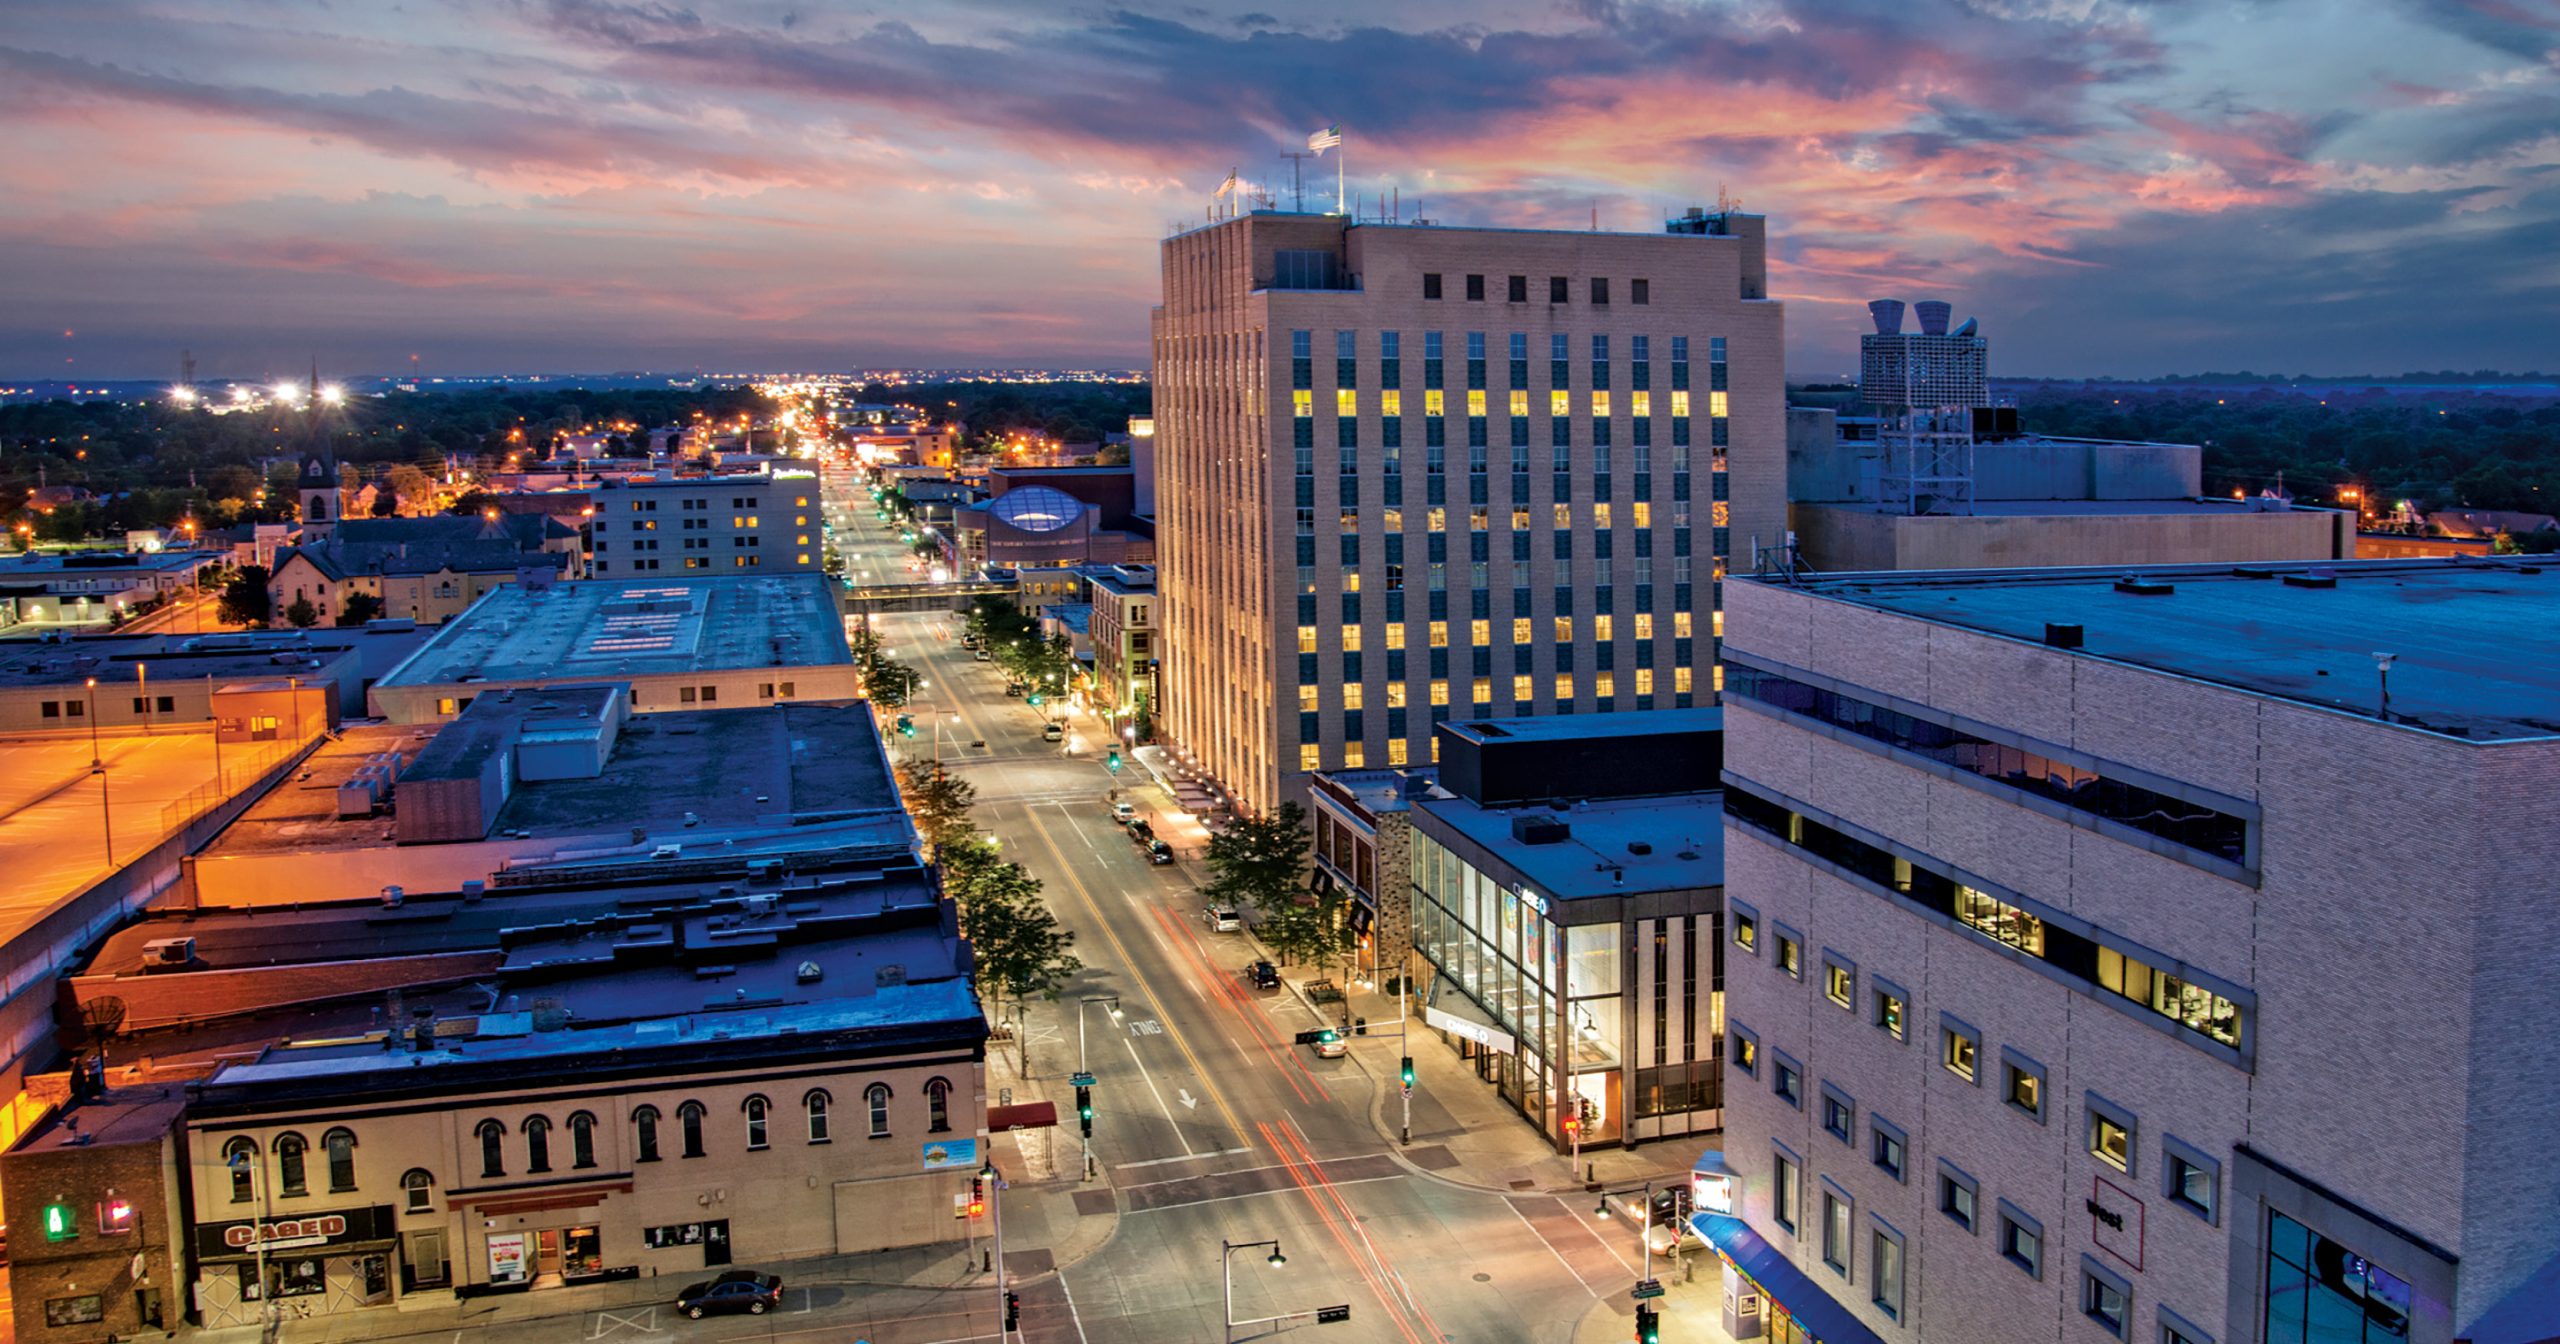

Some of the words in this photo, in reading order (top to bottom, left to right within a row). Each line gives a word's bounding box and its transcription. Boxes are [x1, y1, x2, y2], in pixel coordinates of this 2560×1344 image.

[1513, 882, 1539, 911] CASE
[1128, 1019, 1162, 1037] ONLY
[2086, 1198, 2123, 1232] west
[225, 1215, 346, 1247] CAGED
